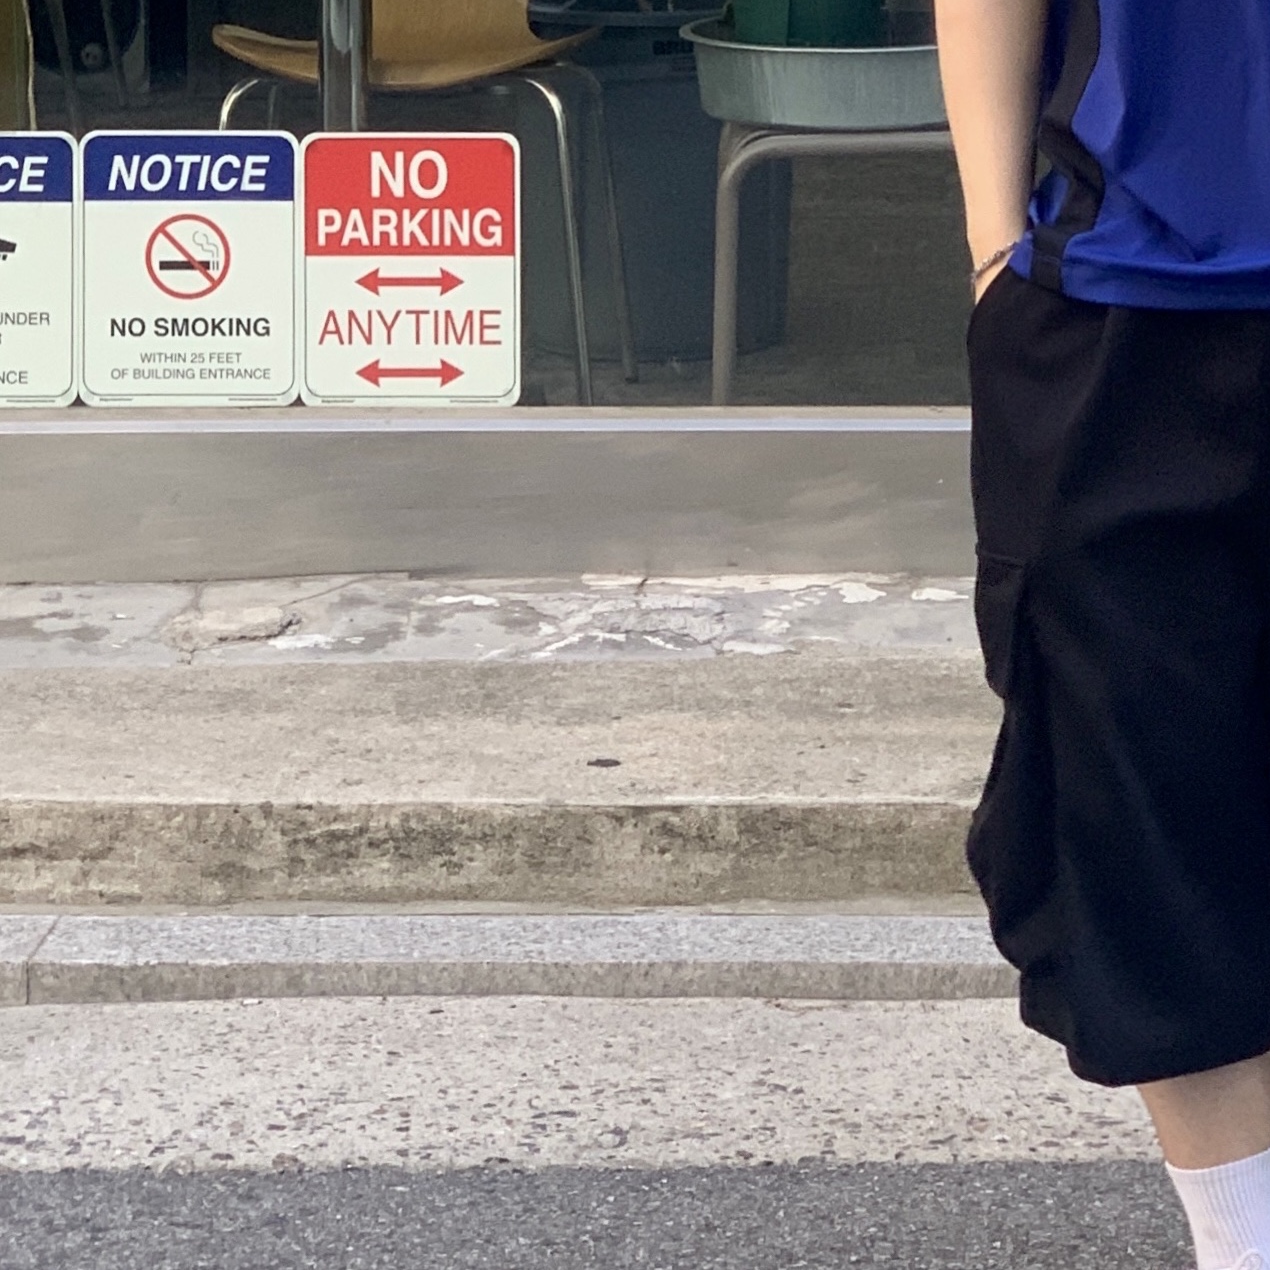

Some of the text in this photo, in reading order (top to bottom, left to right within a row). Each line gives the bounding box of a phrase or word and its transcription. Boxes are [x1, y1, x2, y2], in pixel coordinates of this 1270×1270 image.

[107, 154, 270, 192] NOTICE
[370, 150, 449, 199] NO
[316, 207, 504, 248] PARKING
[110, 317, 271, 338] NO SMOKING
[318, 309, 503, 346] ANYTIME
[111, 368, 271, 381] OF BUILDING ENTRANCE
[140, 352, 242, 364] WITHIN 25 FEET
